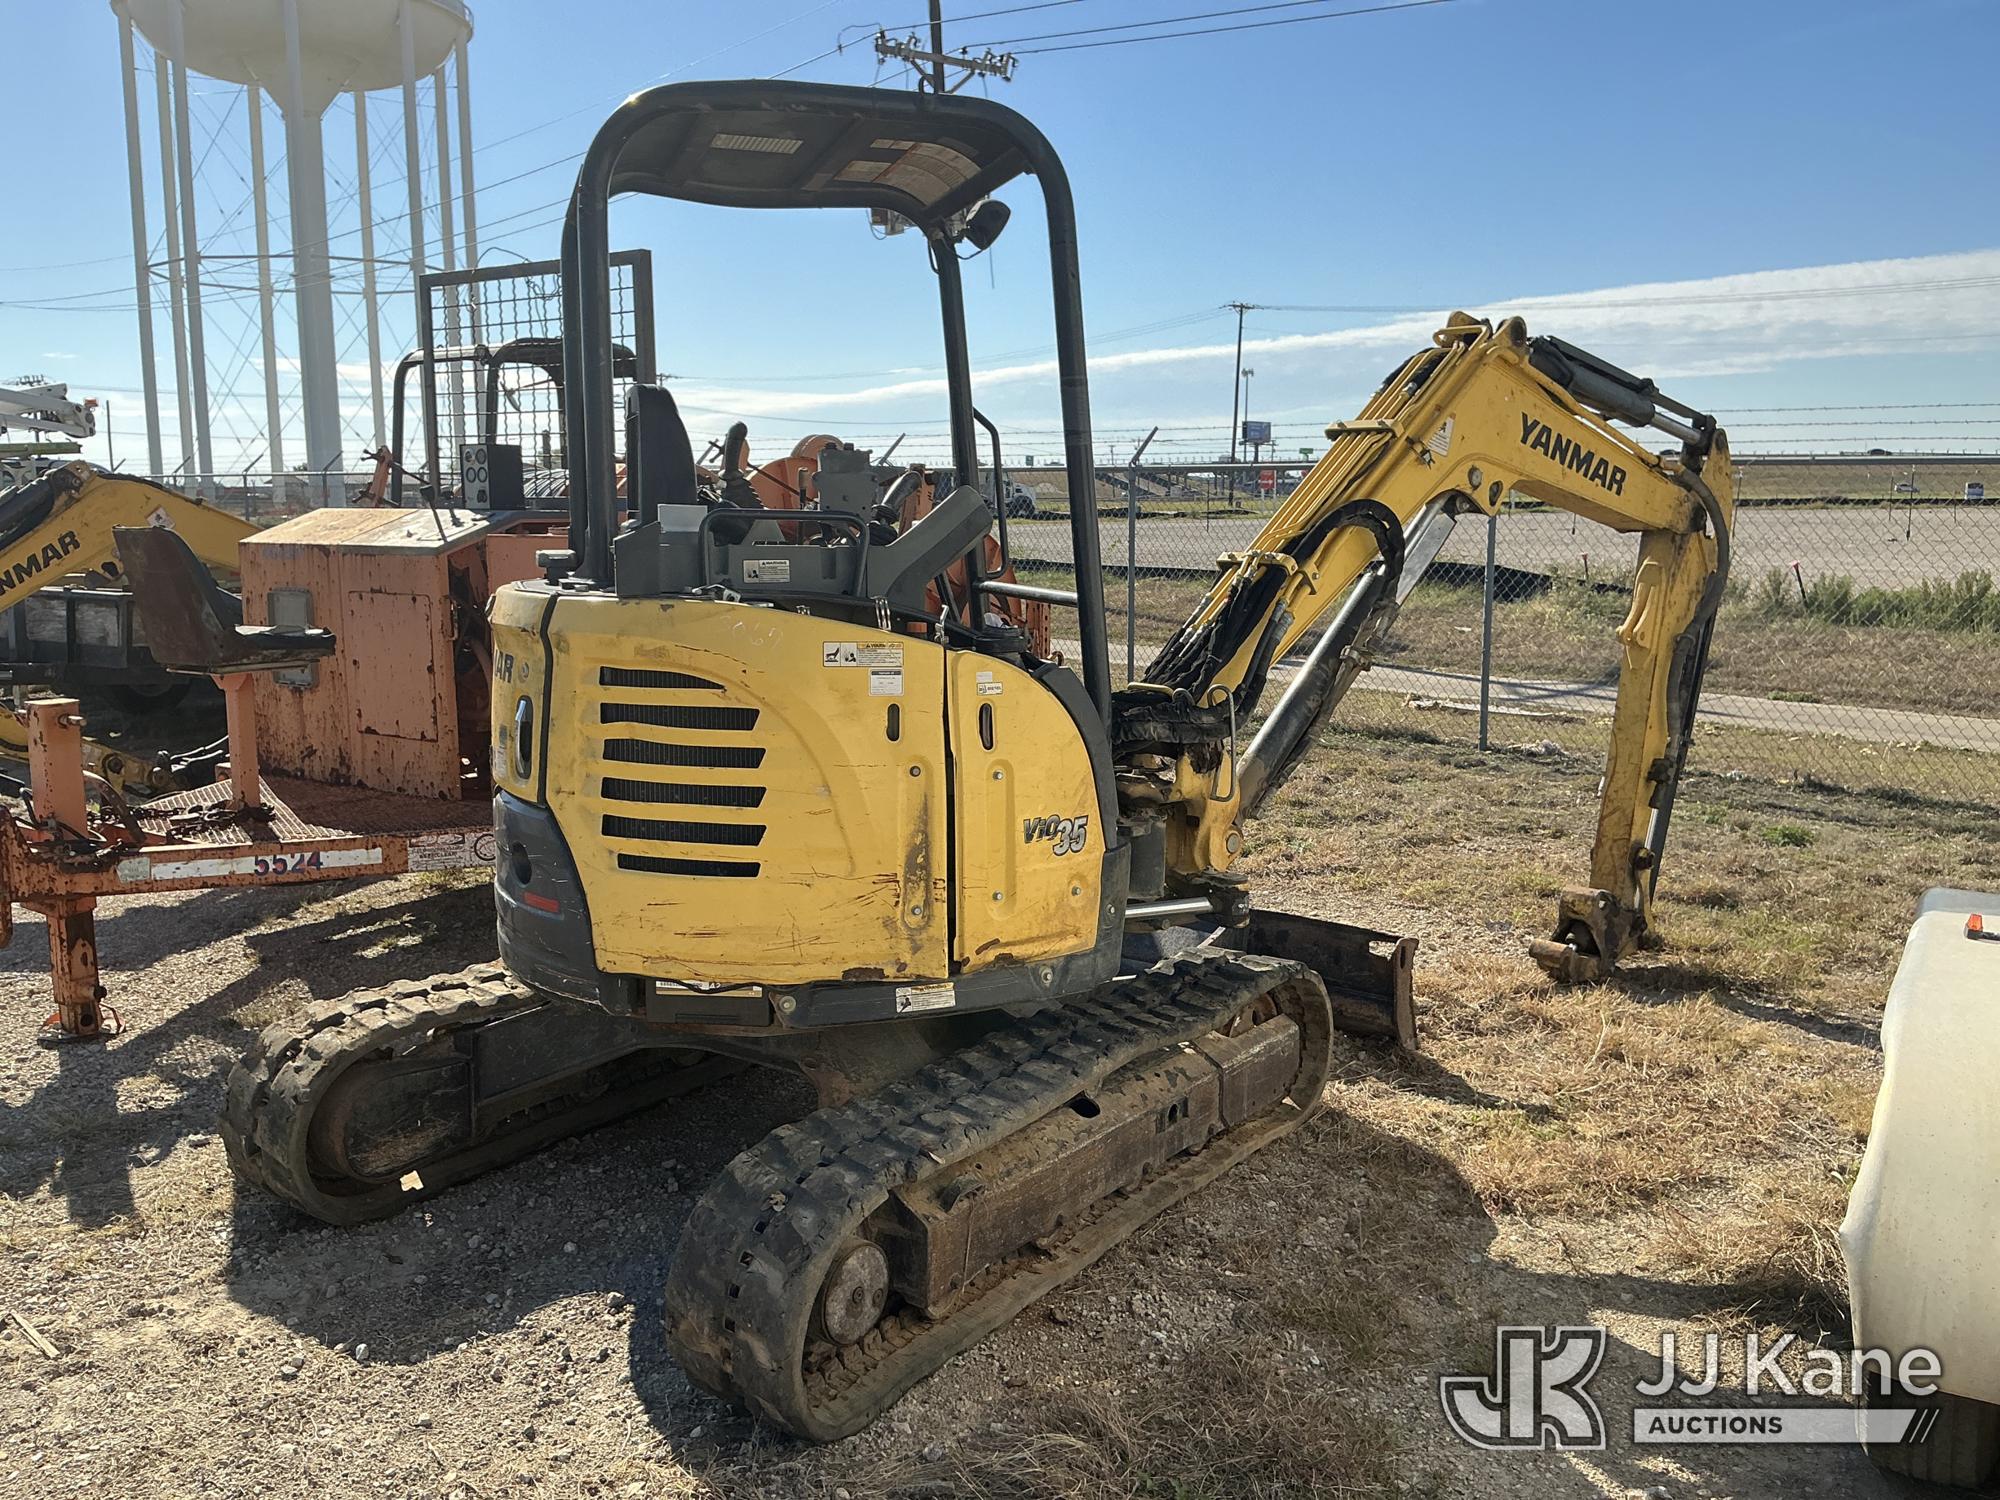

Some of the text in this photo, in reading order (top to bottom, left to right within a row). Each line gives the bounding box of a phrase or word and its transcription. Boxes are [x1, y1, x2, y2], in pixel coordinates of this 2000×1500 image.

[1520, 411, 1627, 497] YANMAR
[494, 648, 514, 684] AR
[254, 848, 324, 877] 5524
